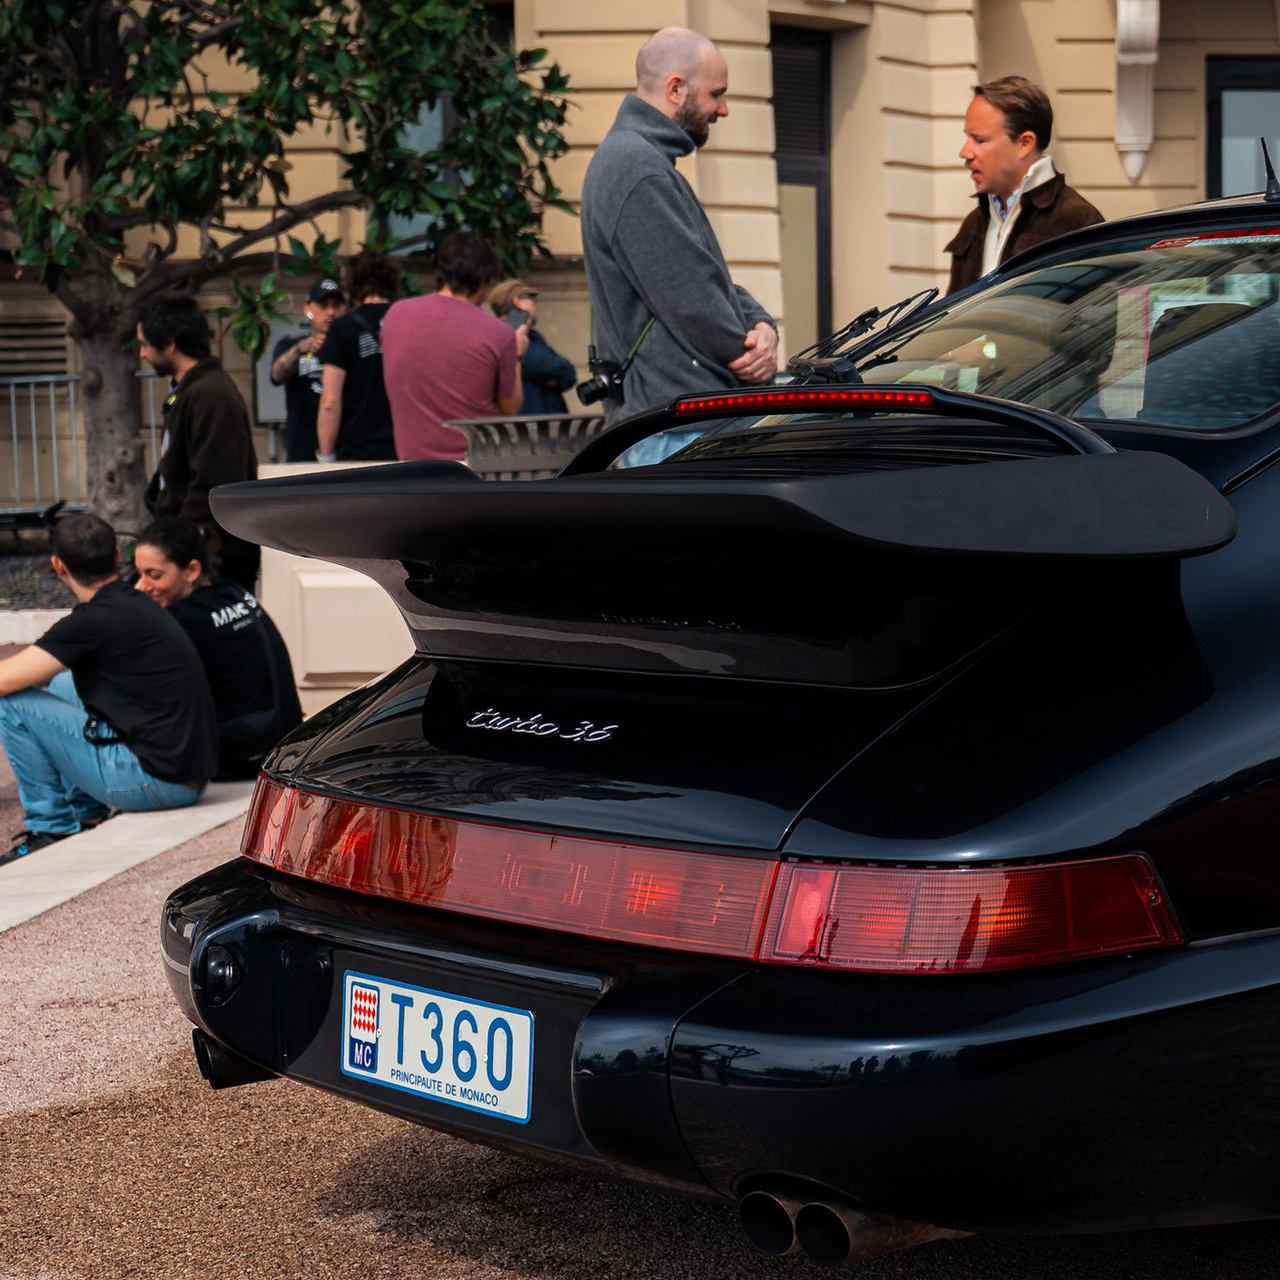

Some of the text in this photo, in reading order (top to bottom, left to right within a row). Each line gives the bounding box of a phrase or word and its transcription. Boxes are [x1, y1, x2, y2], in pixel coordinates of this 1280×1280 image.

[466, 708, 558, 736] turbo
[354, 1043, 372, 1067] MC
[391, 993, 513, 1091] T360
[390, 1068, 498, 1106] PRINCIPAUTE DE MONACO
